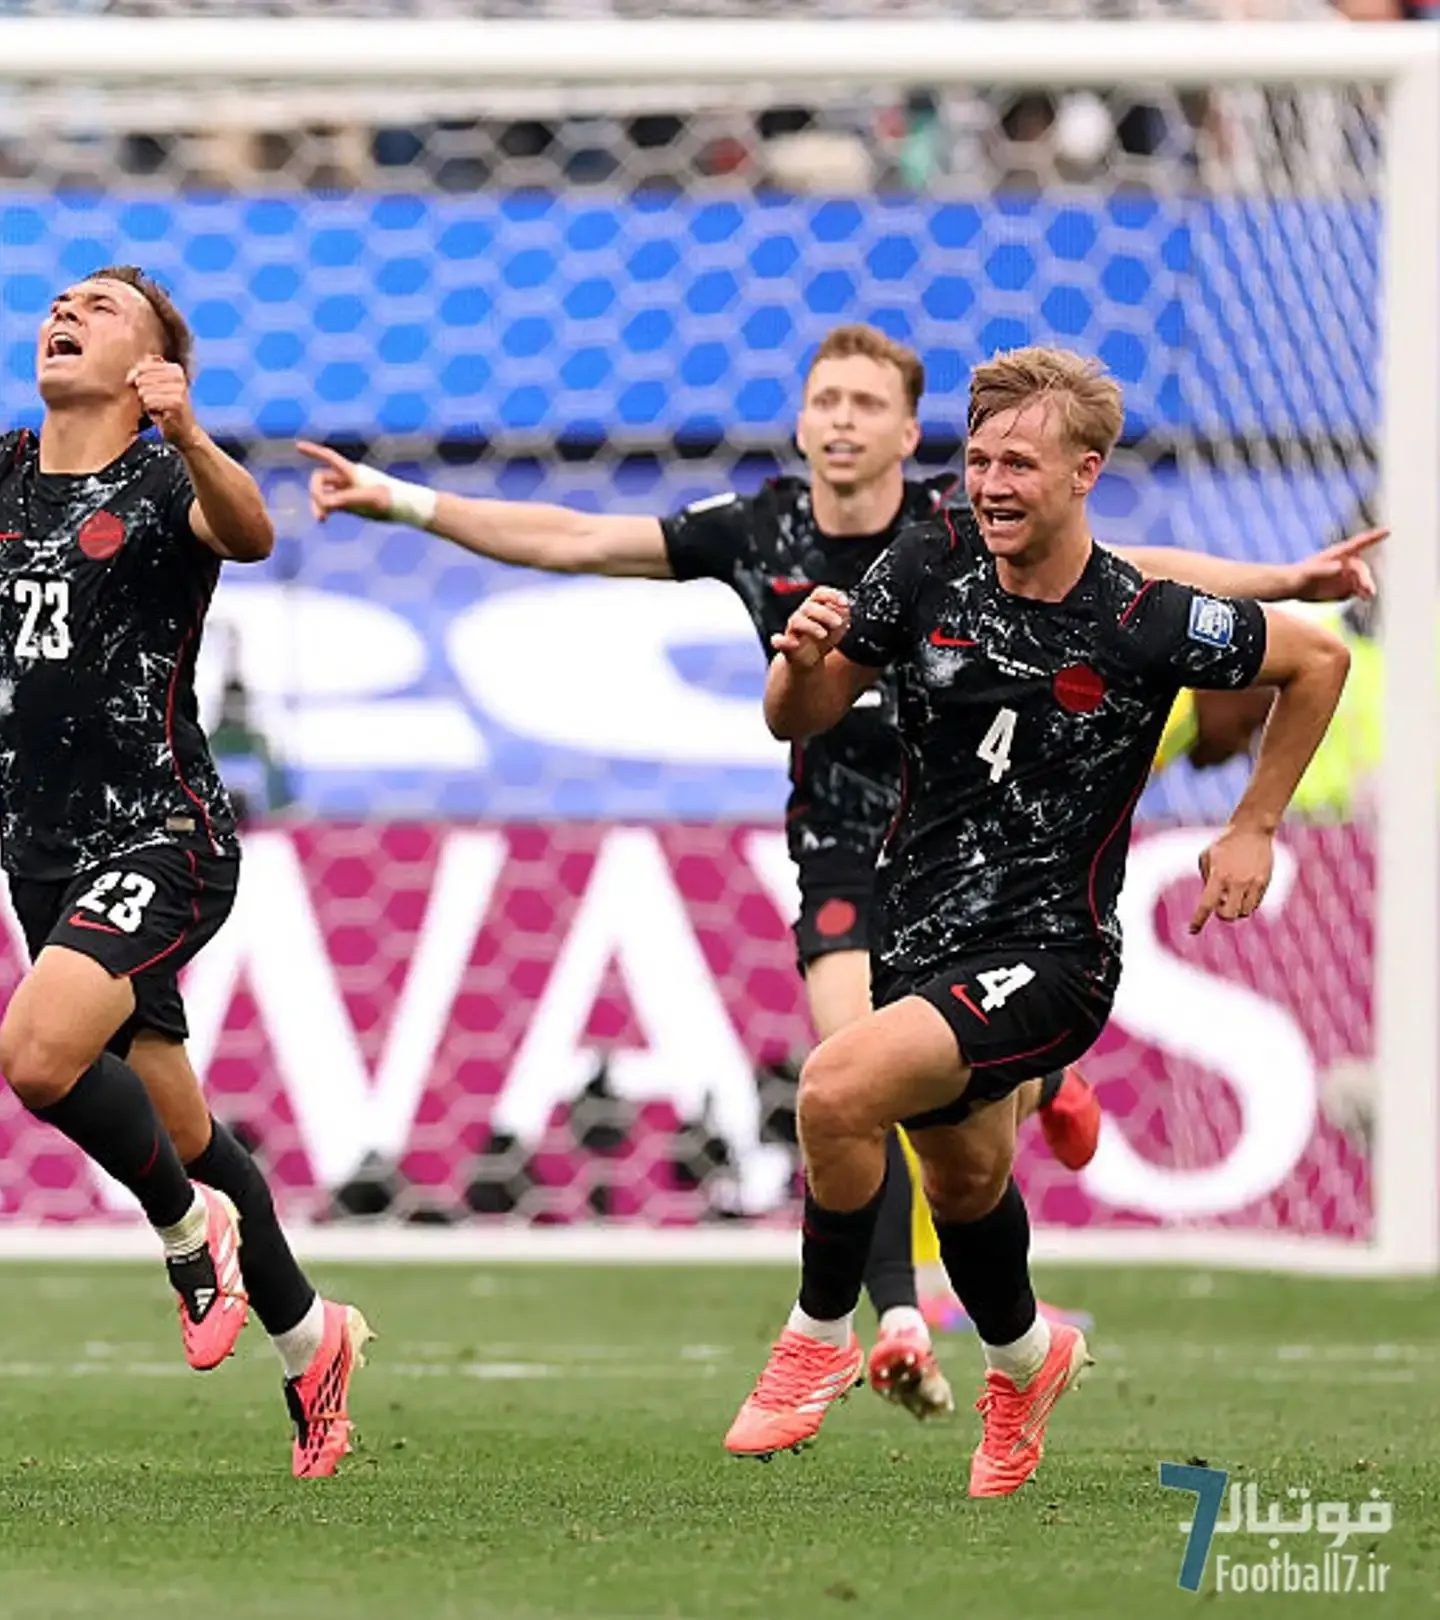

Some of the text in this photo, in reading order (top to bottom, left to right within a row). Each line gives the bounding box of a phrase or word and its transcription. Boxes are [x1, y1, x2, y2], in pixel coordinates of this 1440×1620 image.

[14, 579, 73, 660] 23
[976, 706, 1018, 783] 4
[76, 871, 156, 932] 23
[976, 961, 1036, 1014] 4
